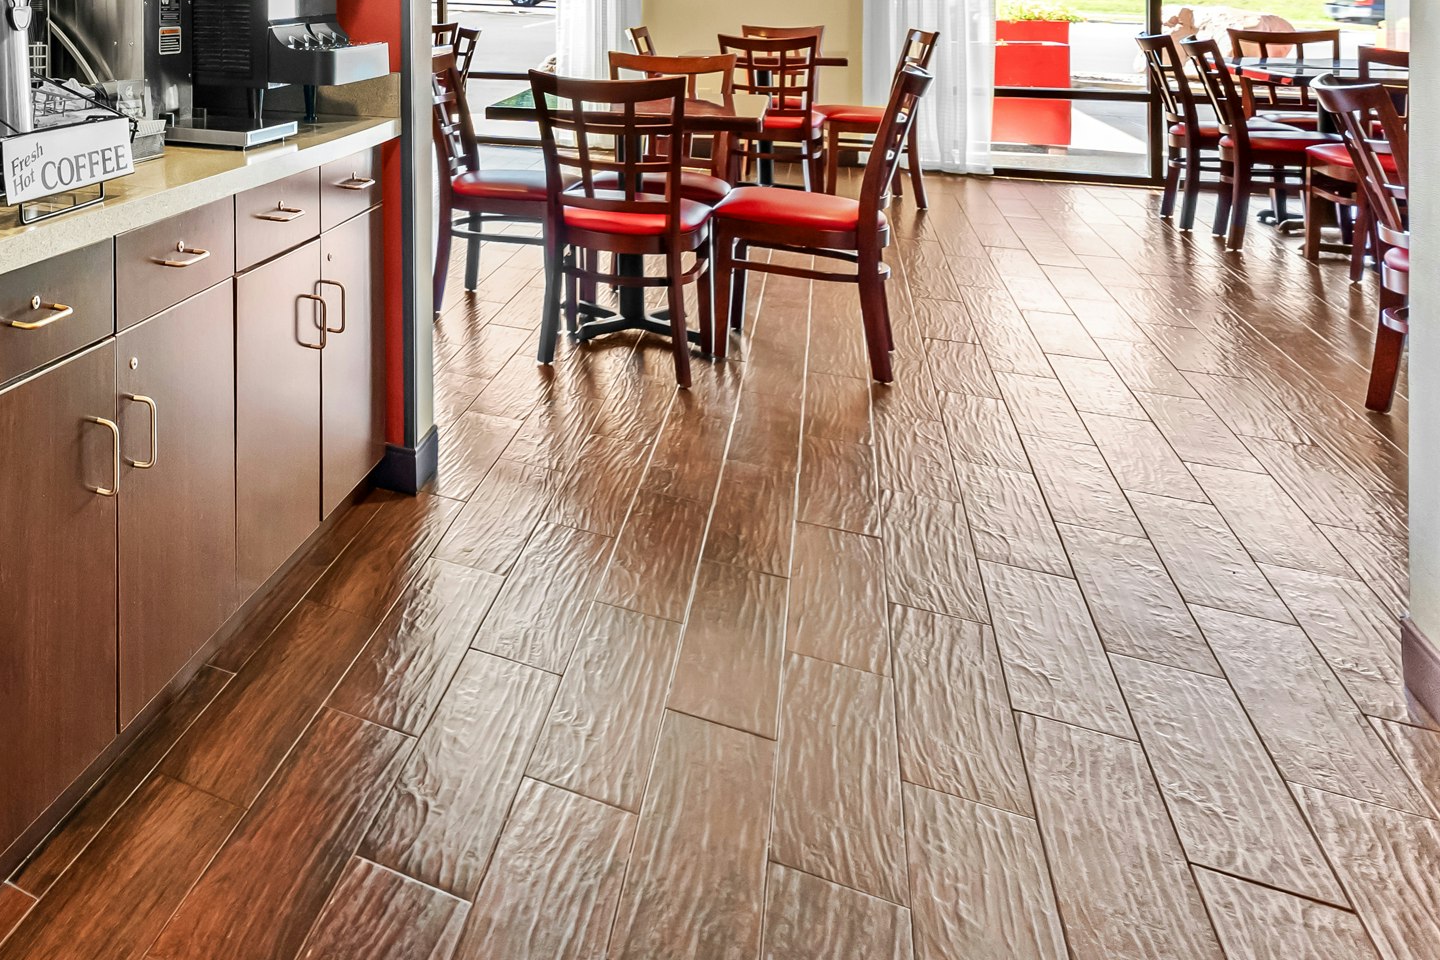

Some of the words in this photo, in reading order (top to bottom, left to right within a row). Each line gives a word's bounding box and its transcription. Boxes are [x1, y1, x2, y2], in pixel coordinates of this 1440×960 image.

[11, 142, 43, 177] Fresh
[13, 168, 34, 196] Hot
[41, 144, 128, 190] COFFEE
